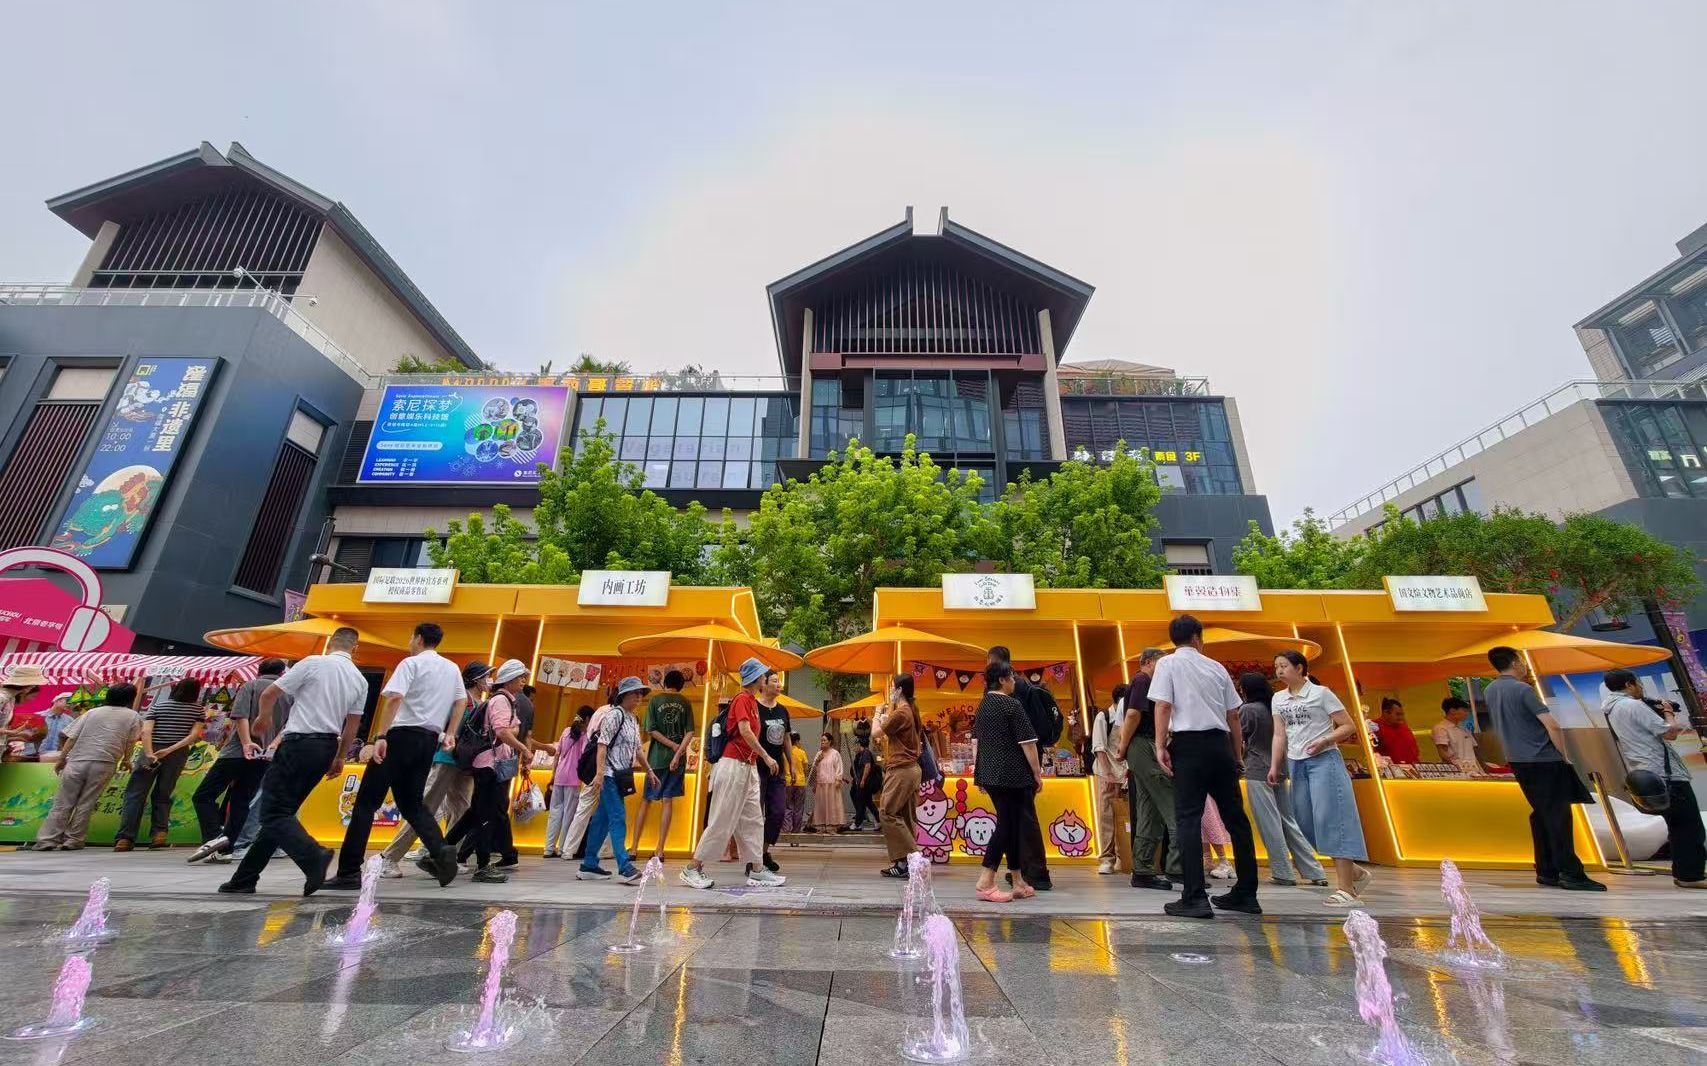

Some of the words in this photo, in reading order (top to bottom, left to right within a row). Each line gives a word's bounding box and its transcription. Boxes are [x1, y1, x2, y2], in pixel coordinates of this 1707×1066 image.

[391, 399, 453, 412] 索尼探梦
[1184, 451, 1201, 461] 3F
[601, 578, 647, 595] 内画工坊
[936, 705, 975, 719] WELCO
